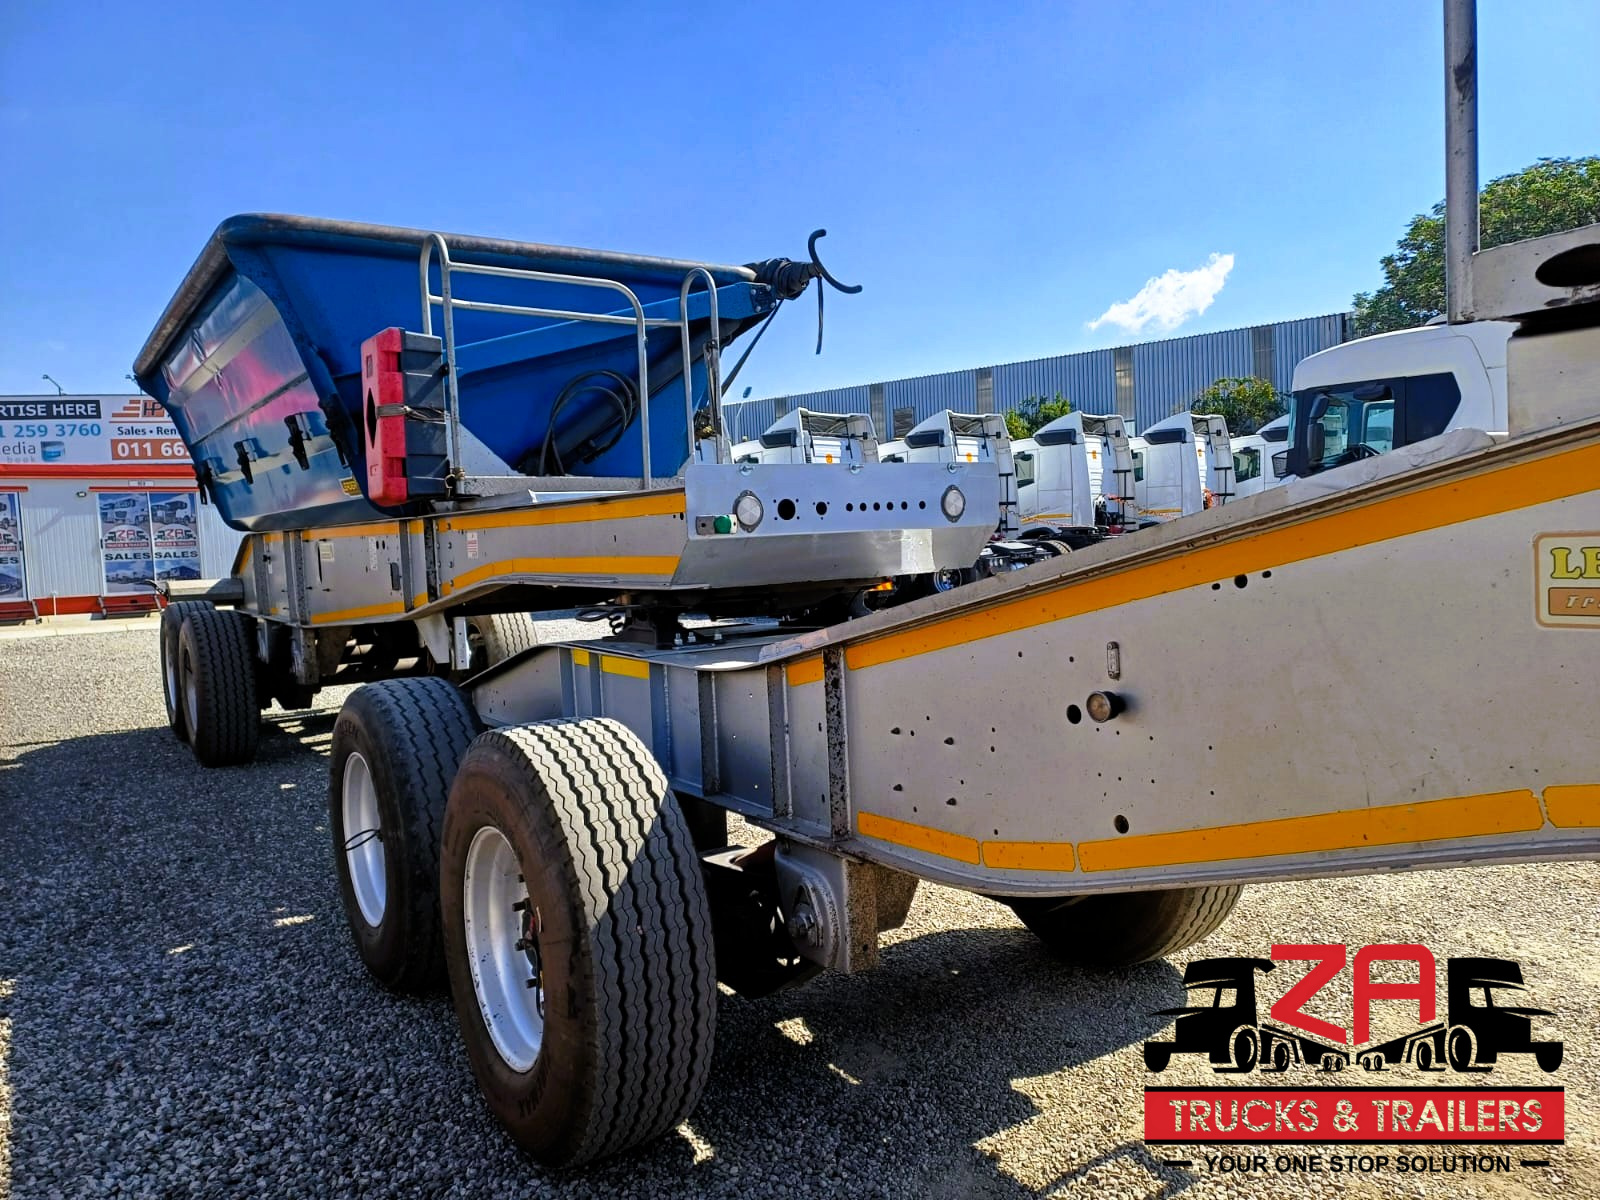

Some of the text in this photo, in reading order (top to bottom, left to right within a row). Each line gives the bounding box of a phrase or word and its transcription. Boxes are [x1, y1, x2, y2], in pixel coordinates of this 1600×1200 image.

[52, 403, 97, 416] HERE
[13, 424, 48, 438] 259
[55, 423, 101, 437] 3760
[117, 426, 147, 435] Sales
[2, 441, 36, 455] edia
[117, 442, 152, 457] 011
[104, 552, 151, 561] SALES
[154, 550, 199, 559] SALES
[1550, 546, 1600, 580] LE
